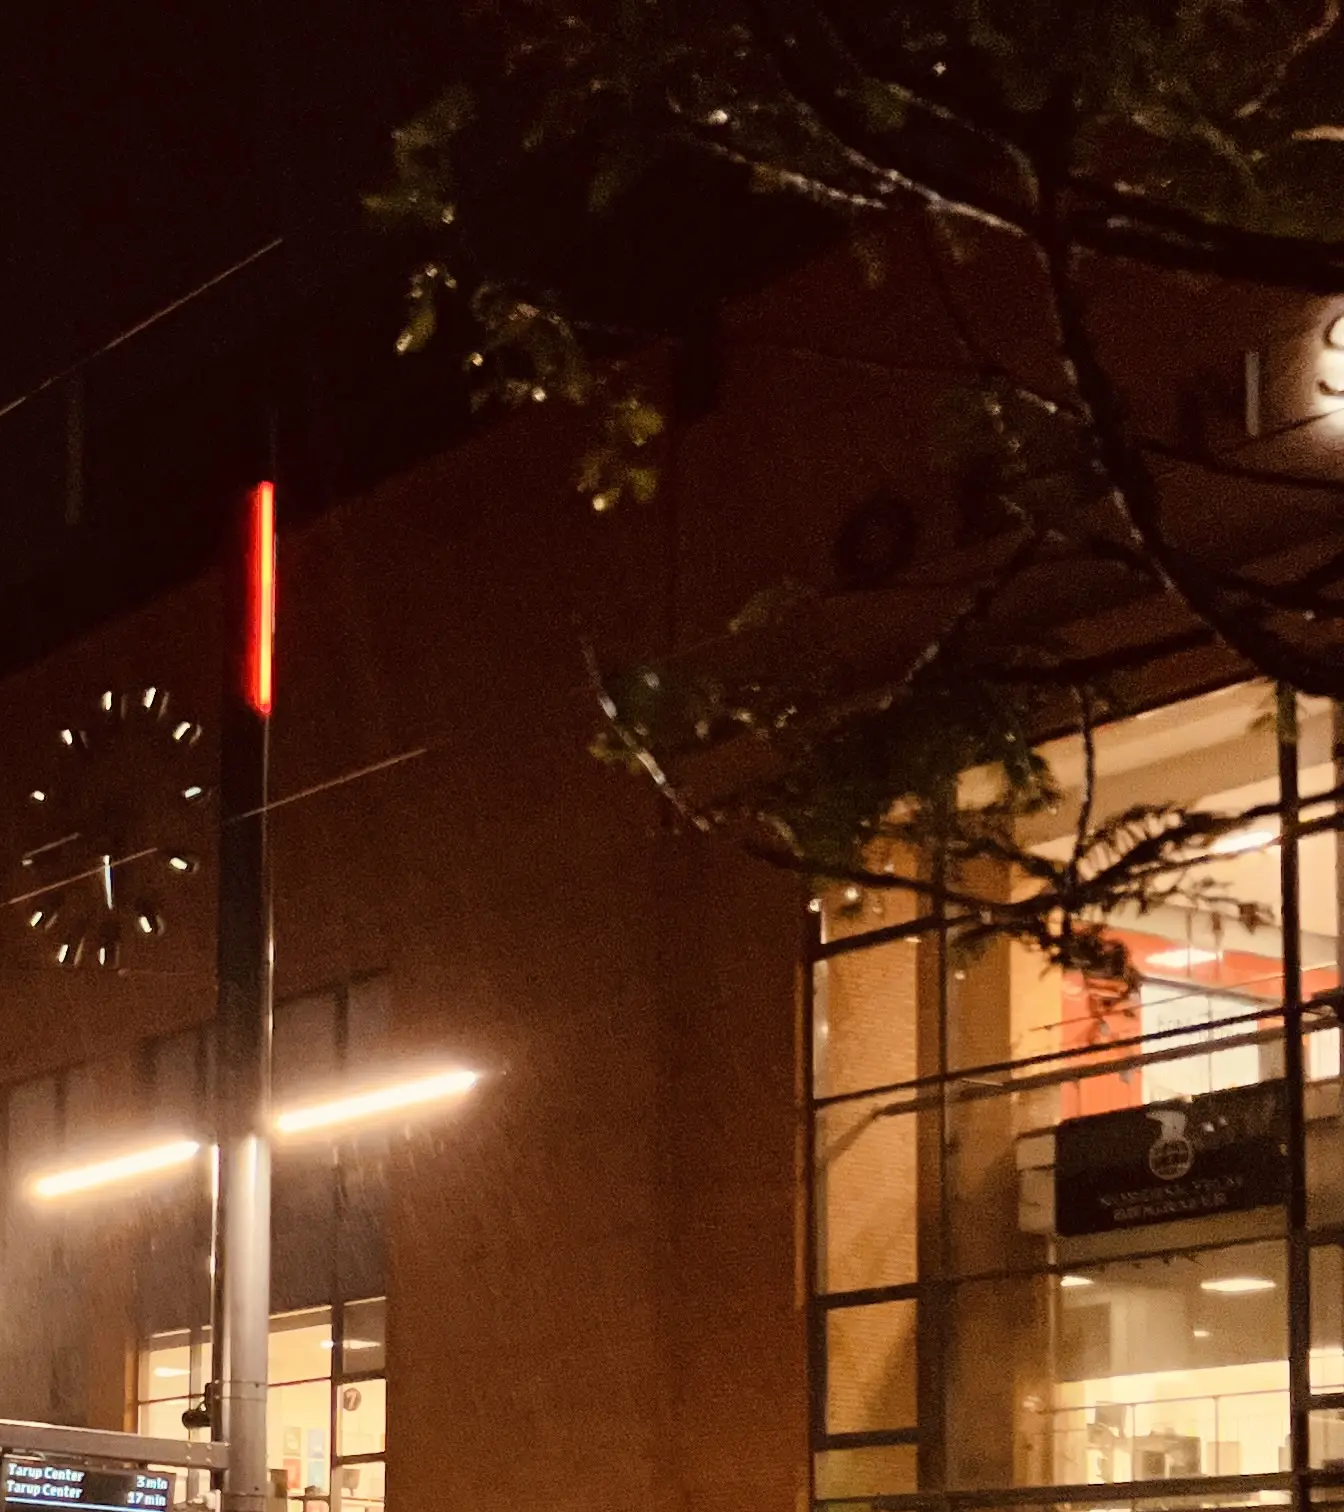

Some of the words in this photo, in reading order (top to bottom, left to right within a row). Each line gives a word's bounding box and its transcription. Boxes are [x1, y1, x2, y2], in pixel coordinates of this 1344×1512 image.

[8, 1463, 44, 1480] Tarup
[44, 1467, 85, 1482] Center
[6, 1480, 42, 1497] Tarup
[43, 1483, 83, 1498] Center
[146, 1477, 168, 1489] min
[127, 1491, 142, 1504] 17
[144, 1493, 166, 1506] min
